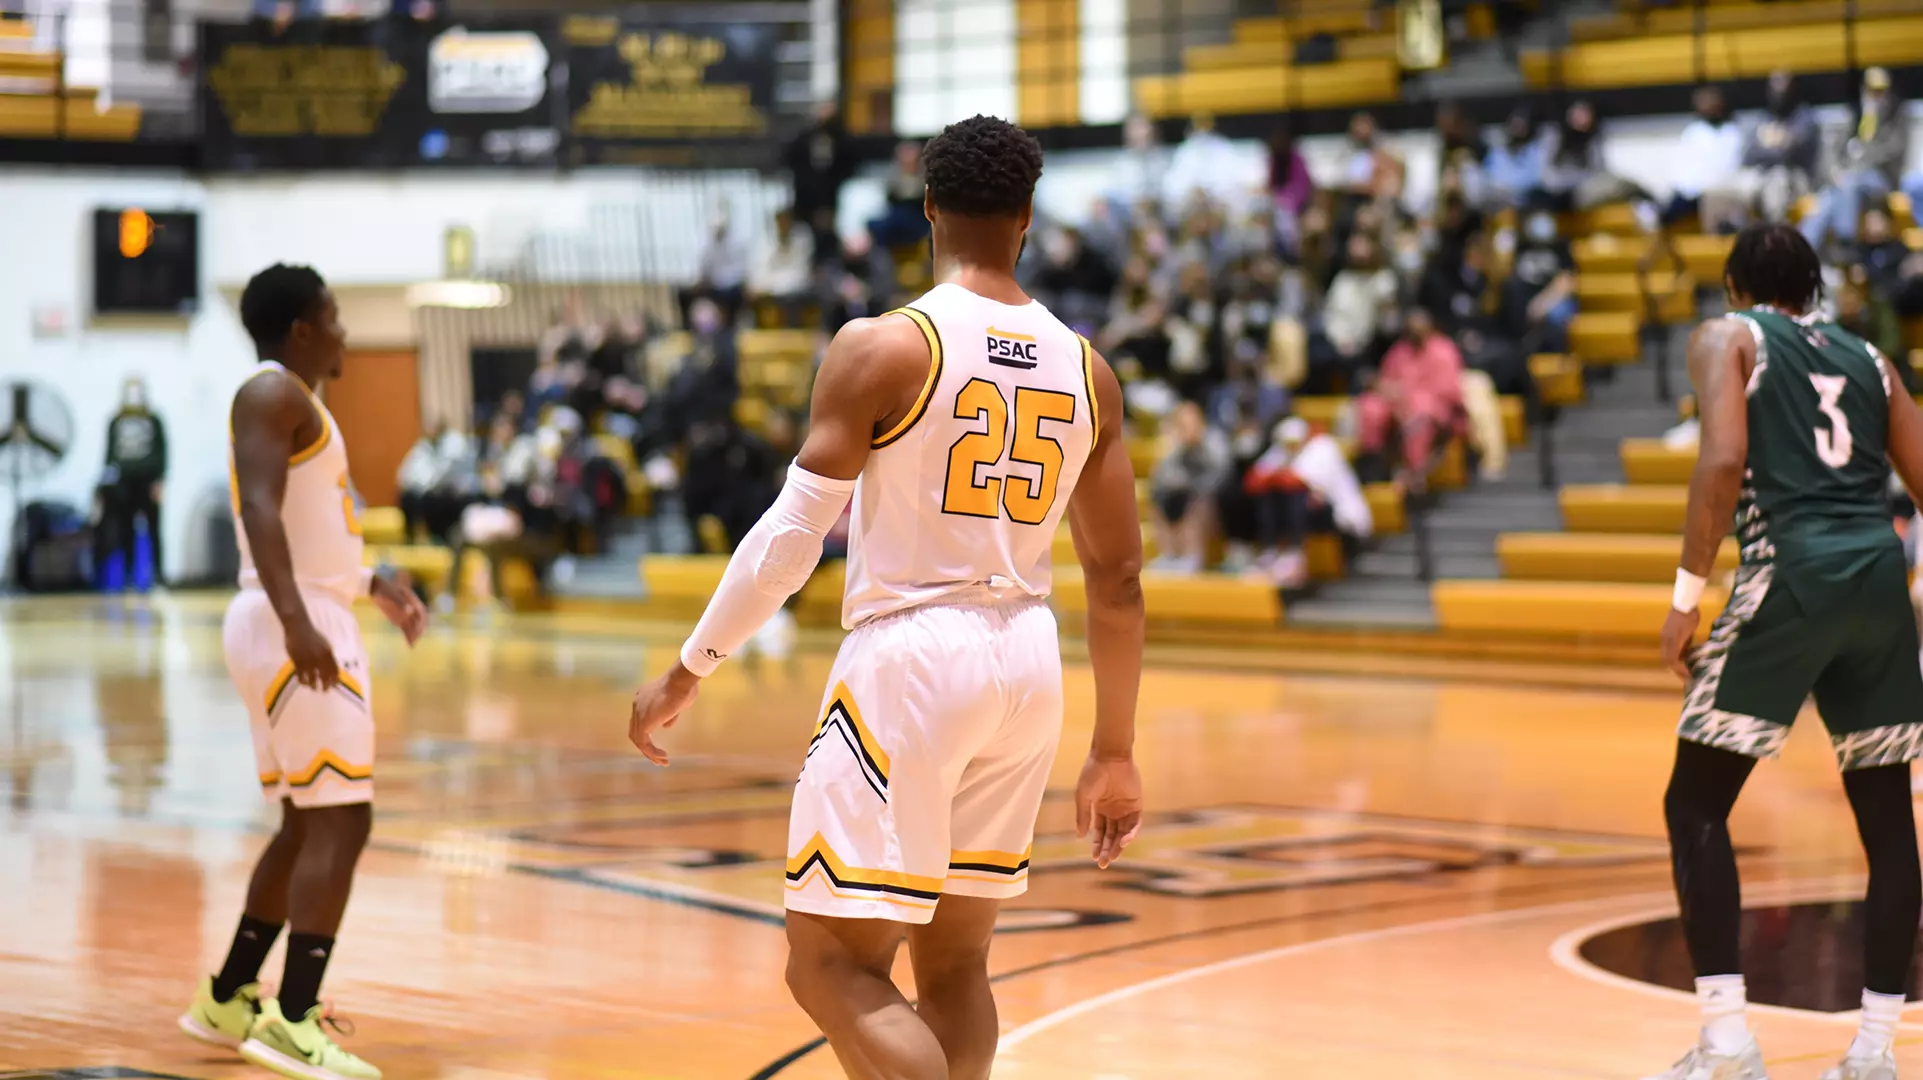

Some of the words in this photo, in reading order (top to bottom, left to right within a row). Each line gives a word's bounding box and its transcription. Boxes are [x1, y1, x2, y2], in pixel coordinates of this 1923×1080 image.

[986, 336, 1038, 361] PSAC
[941, 376, 1076, 526] 25
[1808, 372, 1853, 468] 3
